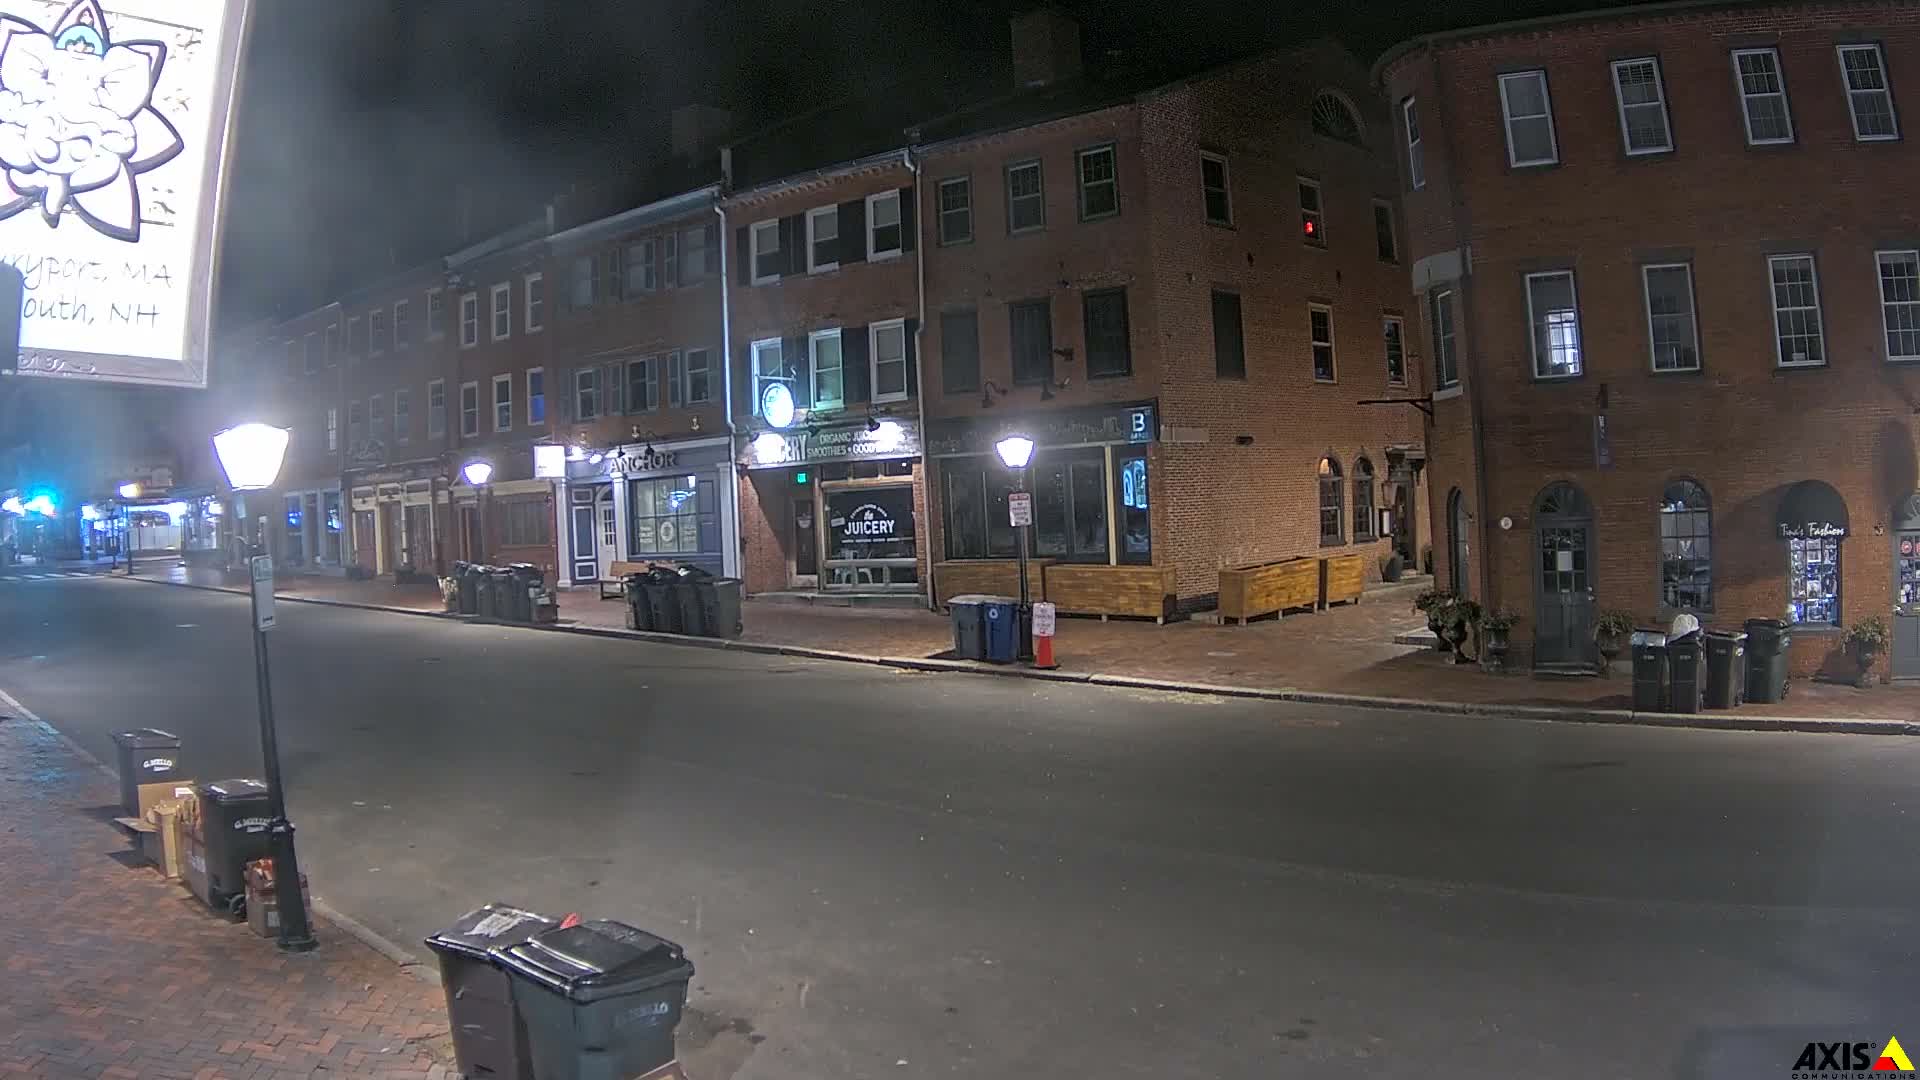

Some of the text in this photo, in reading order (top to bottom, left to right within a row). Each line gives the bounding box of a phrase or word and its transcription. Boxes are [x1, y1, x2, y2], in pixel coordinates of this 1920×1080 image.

[125, 262, 175, 288] MA
[110, 302, 160, 328] NH
[1132, 413, 1145, 432] B
[819, 431, 851, 444] ORGANIC
[806, 446, 847, 457] SMOOTHIES
[609, 451, 679, 472] ANCHOR
[844, 519, 895, 536] JUICERY
